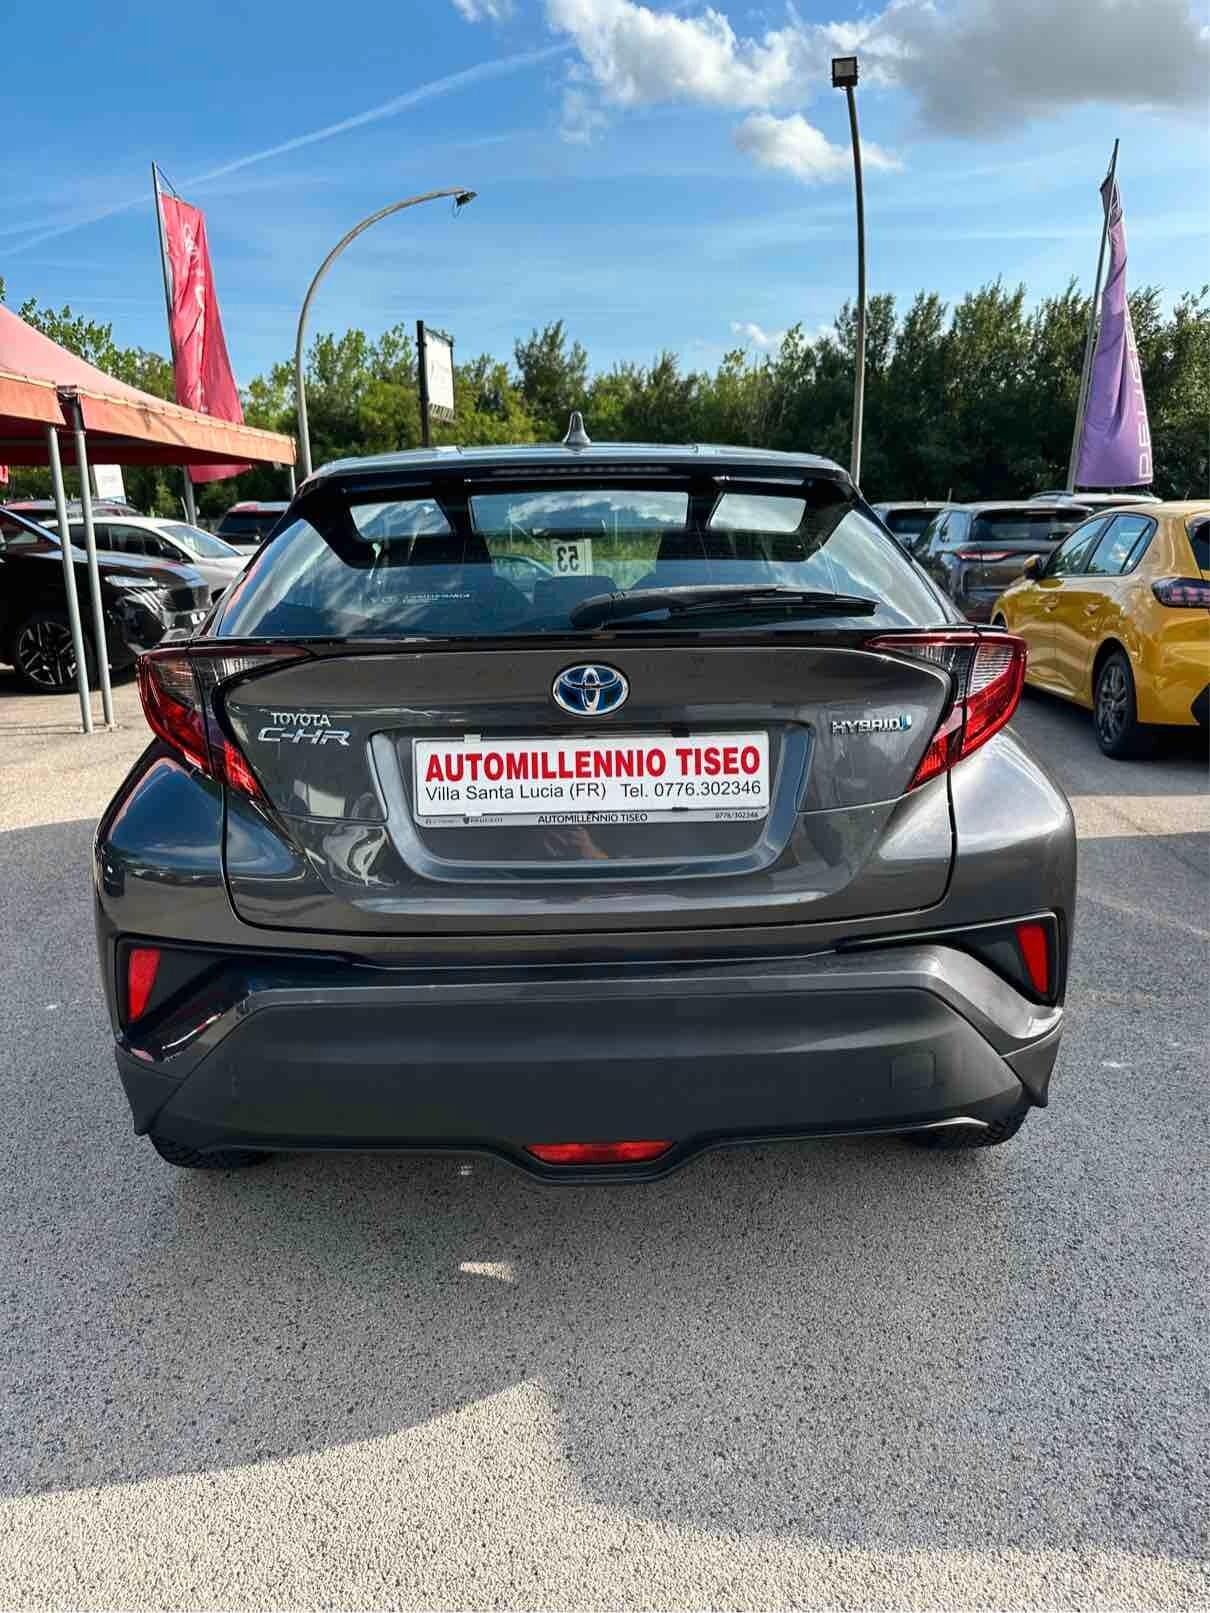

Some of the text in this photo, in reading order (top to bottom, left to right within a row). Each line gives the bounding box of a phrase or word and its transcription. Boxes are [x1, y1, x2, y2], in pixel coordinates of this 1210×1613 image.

[270, 712, 331, 727] TOYOTA
[831, 719, 899, 735] HYBRID
[258, 727, 350, 746] C-HR
[425, 746, 760, 782] AUTOMILLENNIO TISEO
[426, 780, 761, 801] Villa Santa Lucia (FR) Tel. 0776.302346
[537, 813, 648, 824] AUTOMILLENNIO TISEO
